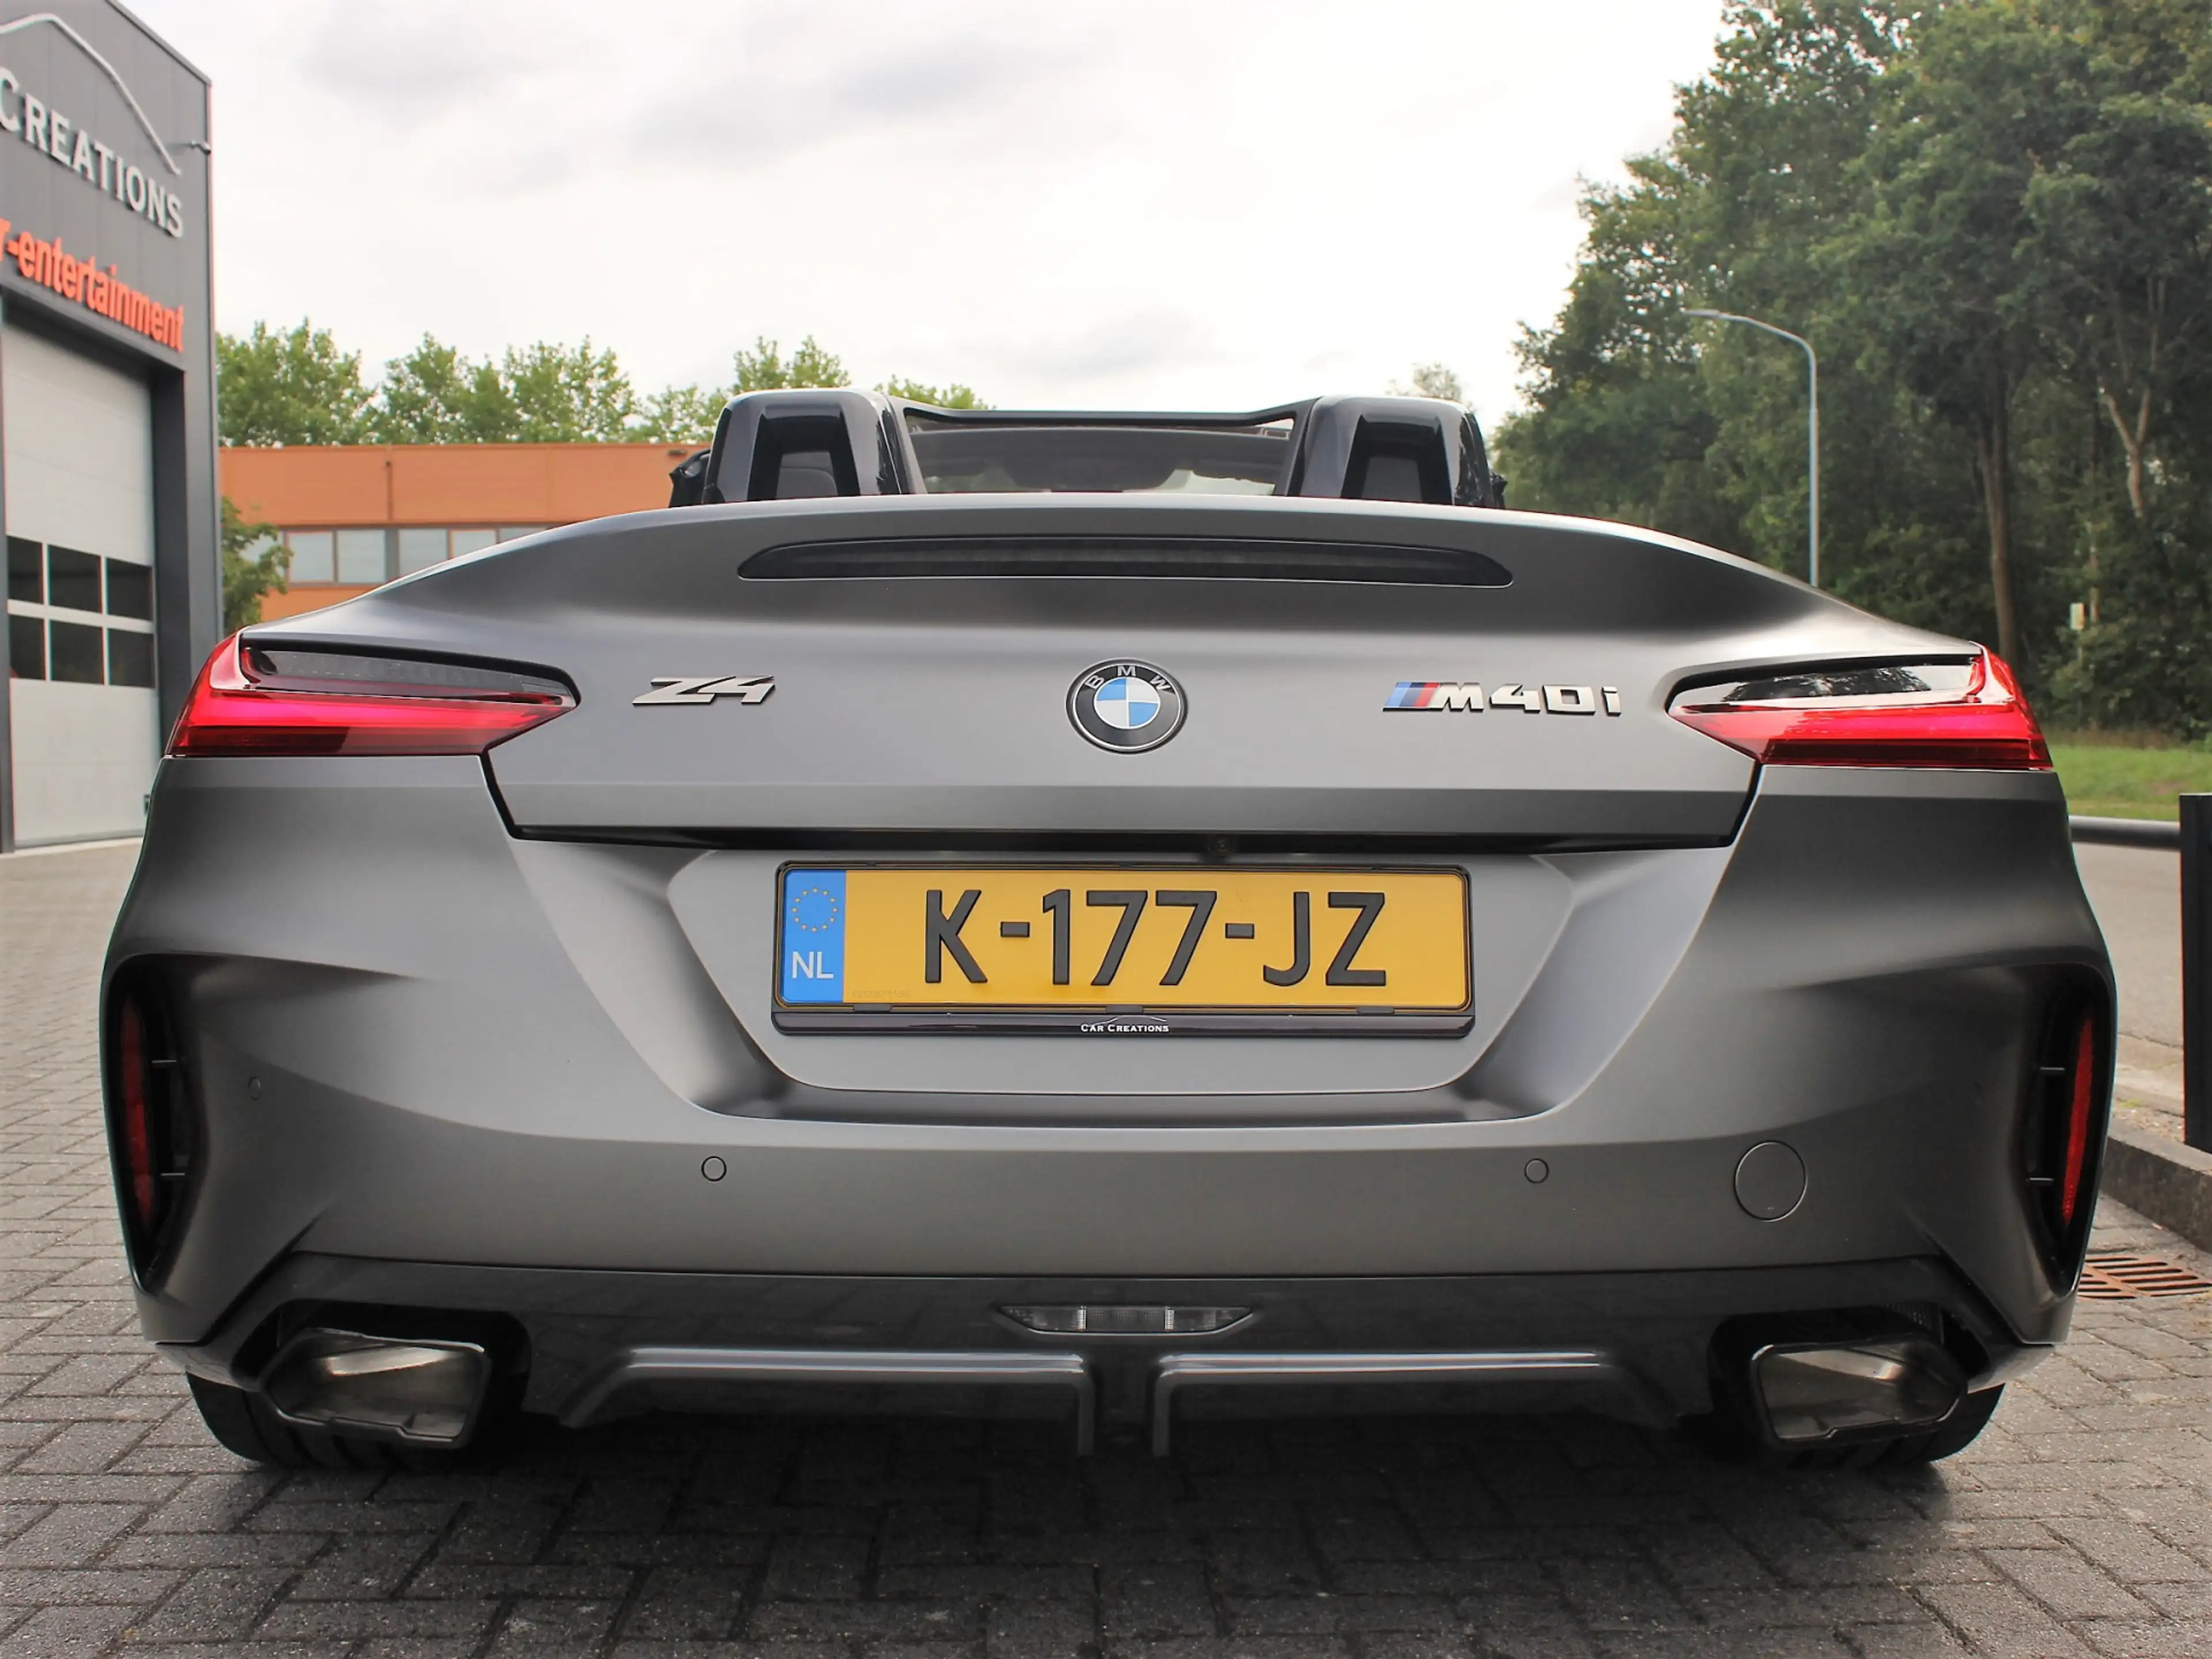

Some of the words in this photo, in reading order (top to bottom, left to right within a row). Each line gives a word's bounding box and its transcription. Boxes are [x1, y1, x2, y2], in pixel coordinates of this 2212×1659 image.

[0, 67, 183, 238] CREATIONS
[631, 675, 775, 704] Z4
[1085, 665, 1171, 691] BMW
[1427, 682, 1622, 716] M40i
[924, 889, 1387, 987] K-177-JZ
[792, 951, 834, 979] NL
[1081, 1024, 1104, 1032] CAR
[1107, 1024, 1169, 1032] CREATIONS
